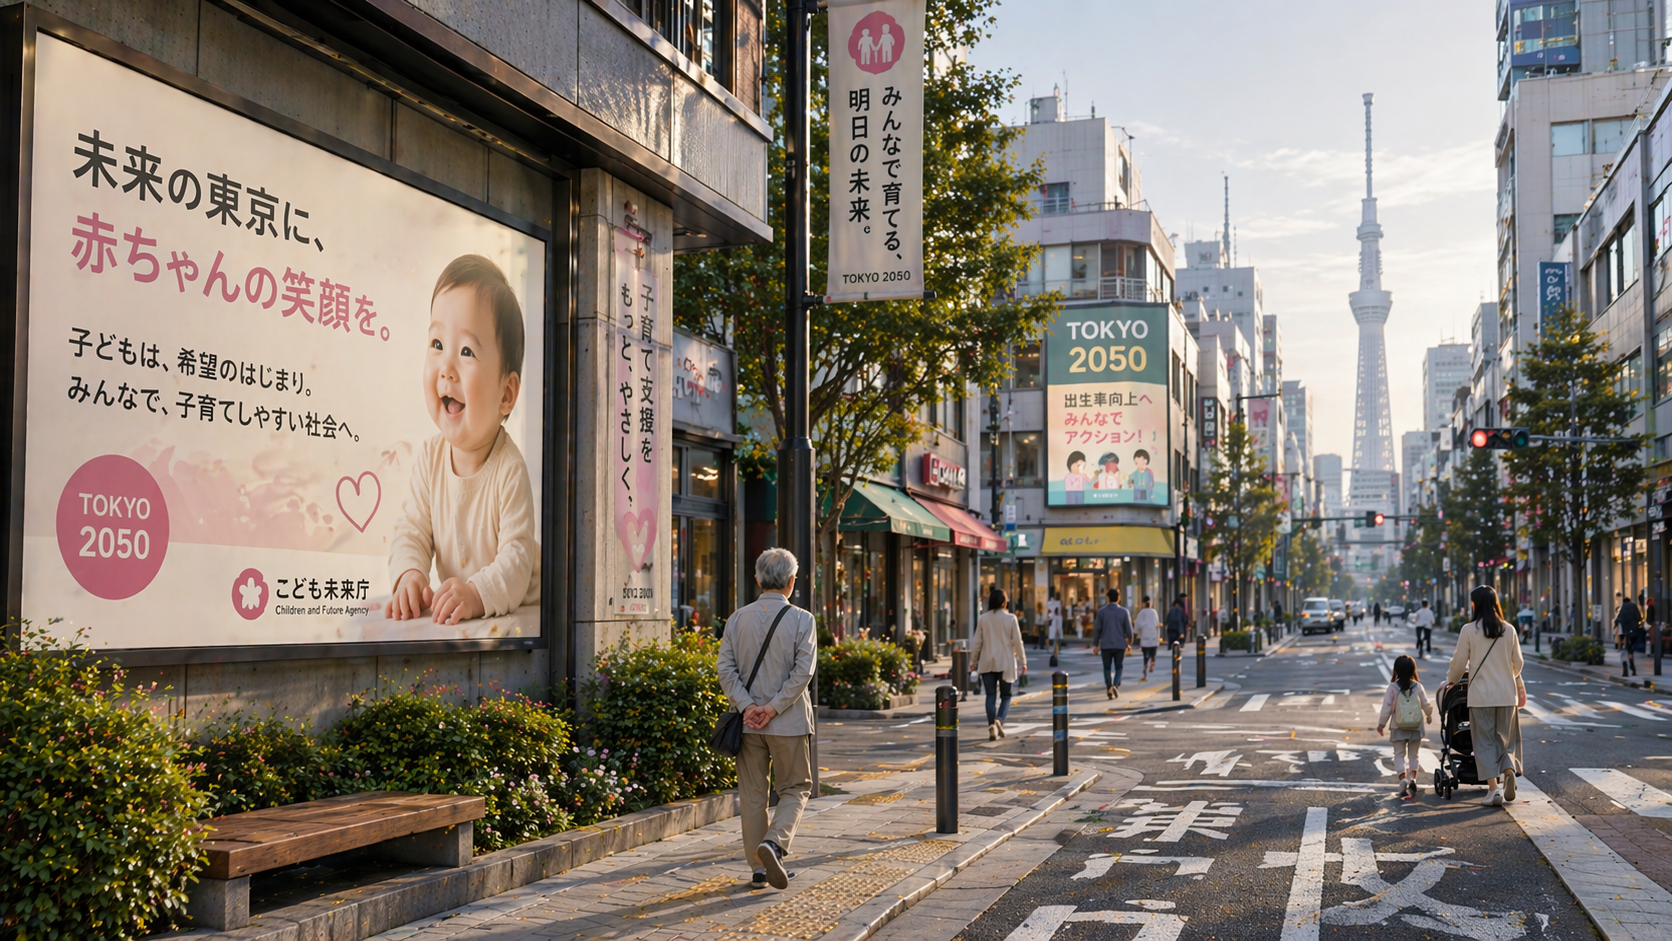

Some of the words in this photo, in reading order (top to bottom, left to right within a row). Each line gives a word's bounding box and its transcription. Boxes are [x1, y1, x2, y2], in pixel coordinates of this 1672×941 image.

[881, 86, 903, 260] みんなで育てる、
[72, 129, 324, 252] 未来の東京に、
[70, 211, 391, 342] 赤ちゃんの笑顔を。
[842, 272, 880, 284] TOKYO
[882, 270, 911, 282] 2050
[1065, 319, 1149, 340] TOKYO
[68, 327, 312, 397] 子どもは、希望のはじまり。
[1068, 345, 1148, 374] 2050
[67, 375, 360, 442] みんなで、子育てしやすい社会へ。
[1064, 391, 1153, 408] 出生率向上へ
[1064, 411, 1123, 427] みんなで
[1064, 429, 1142, 445] アクション!
[78, 492, 151, 520] TOKYO
[78, 525, 151, 560] 2050
[276, 578, 370, 601] こども未来庁
[275, 604, 306, 615] Children
[307, 605, 321, 615] and
[345, 605, 370, 617] Agency
